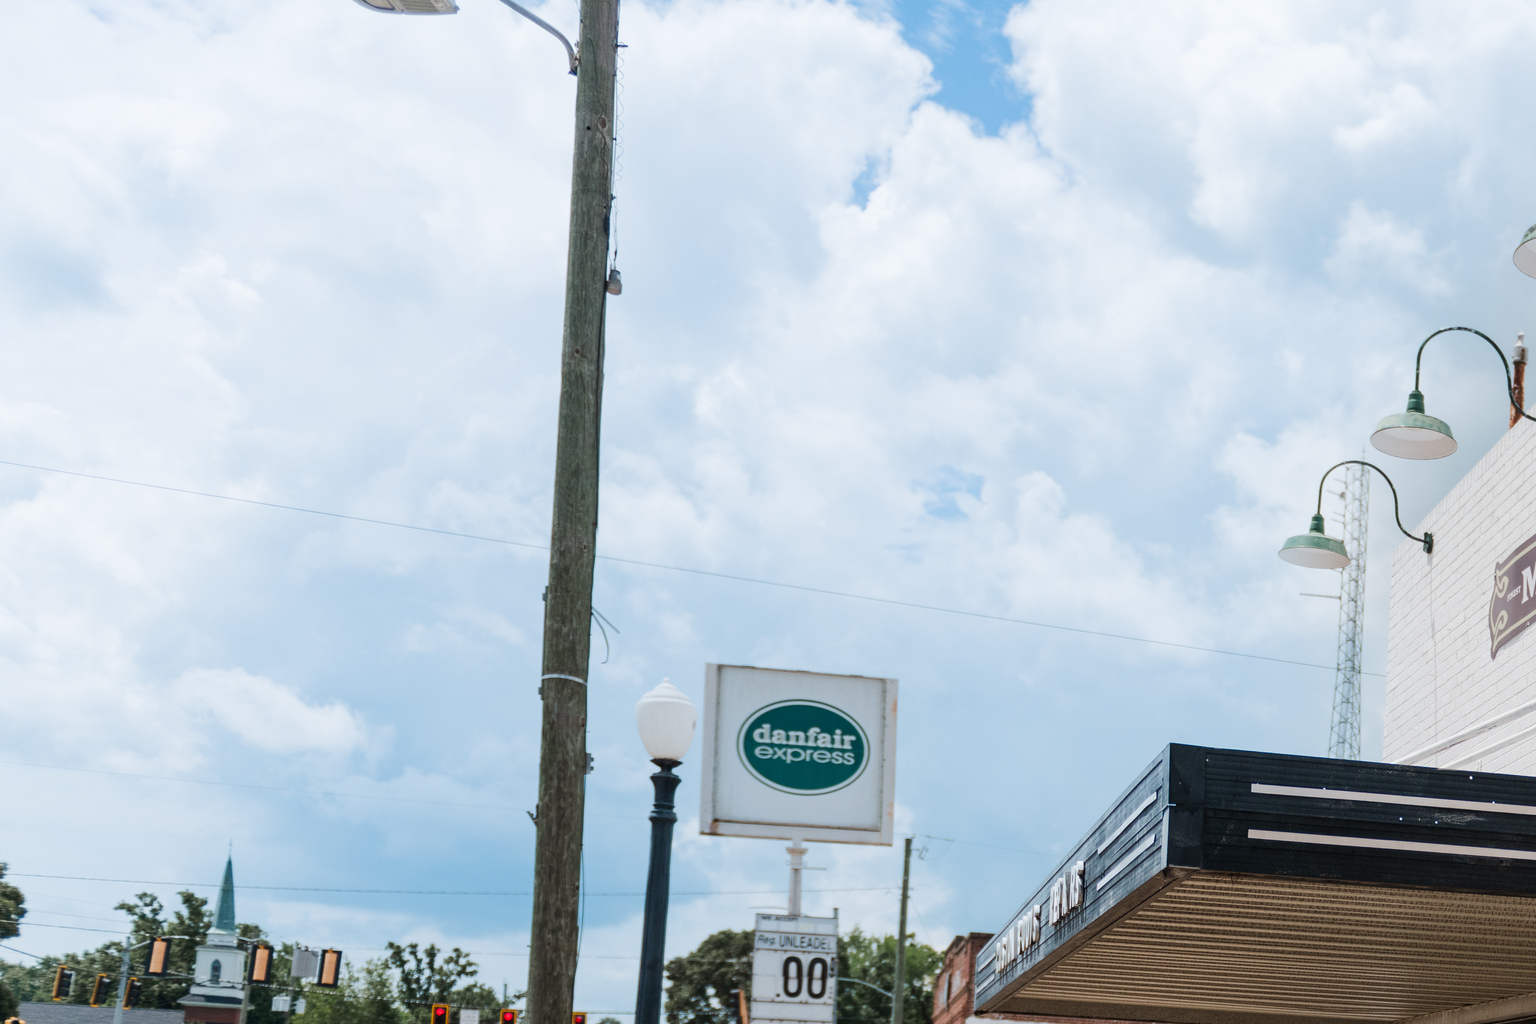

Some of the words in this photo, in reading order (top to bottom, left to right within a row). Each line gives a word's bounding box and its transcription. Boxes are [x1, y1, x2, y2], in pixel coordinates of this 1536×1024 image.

[752, 723, 857, 750] danfair
[754, 744, 856, 766] express
[757, 934, 776, 946] Reg.
